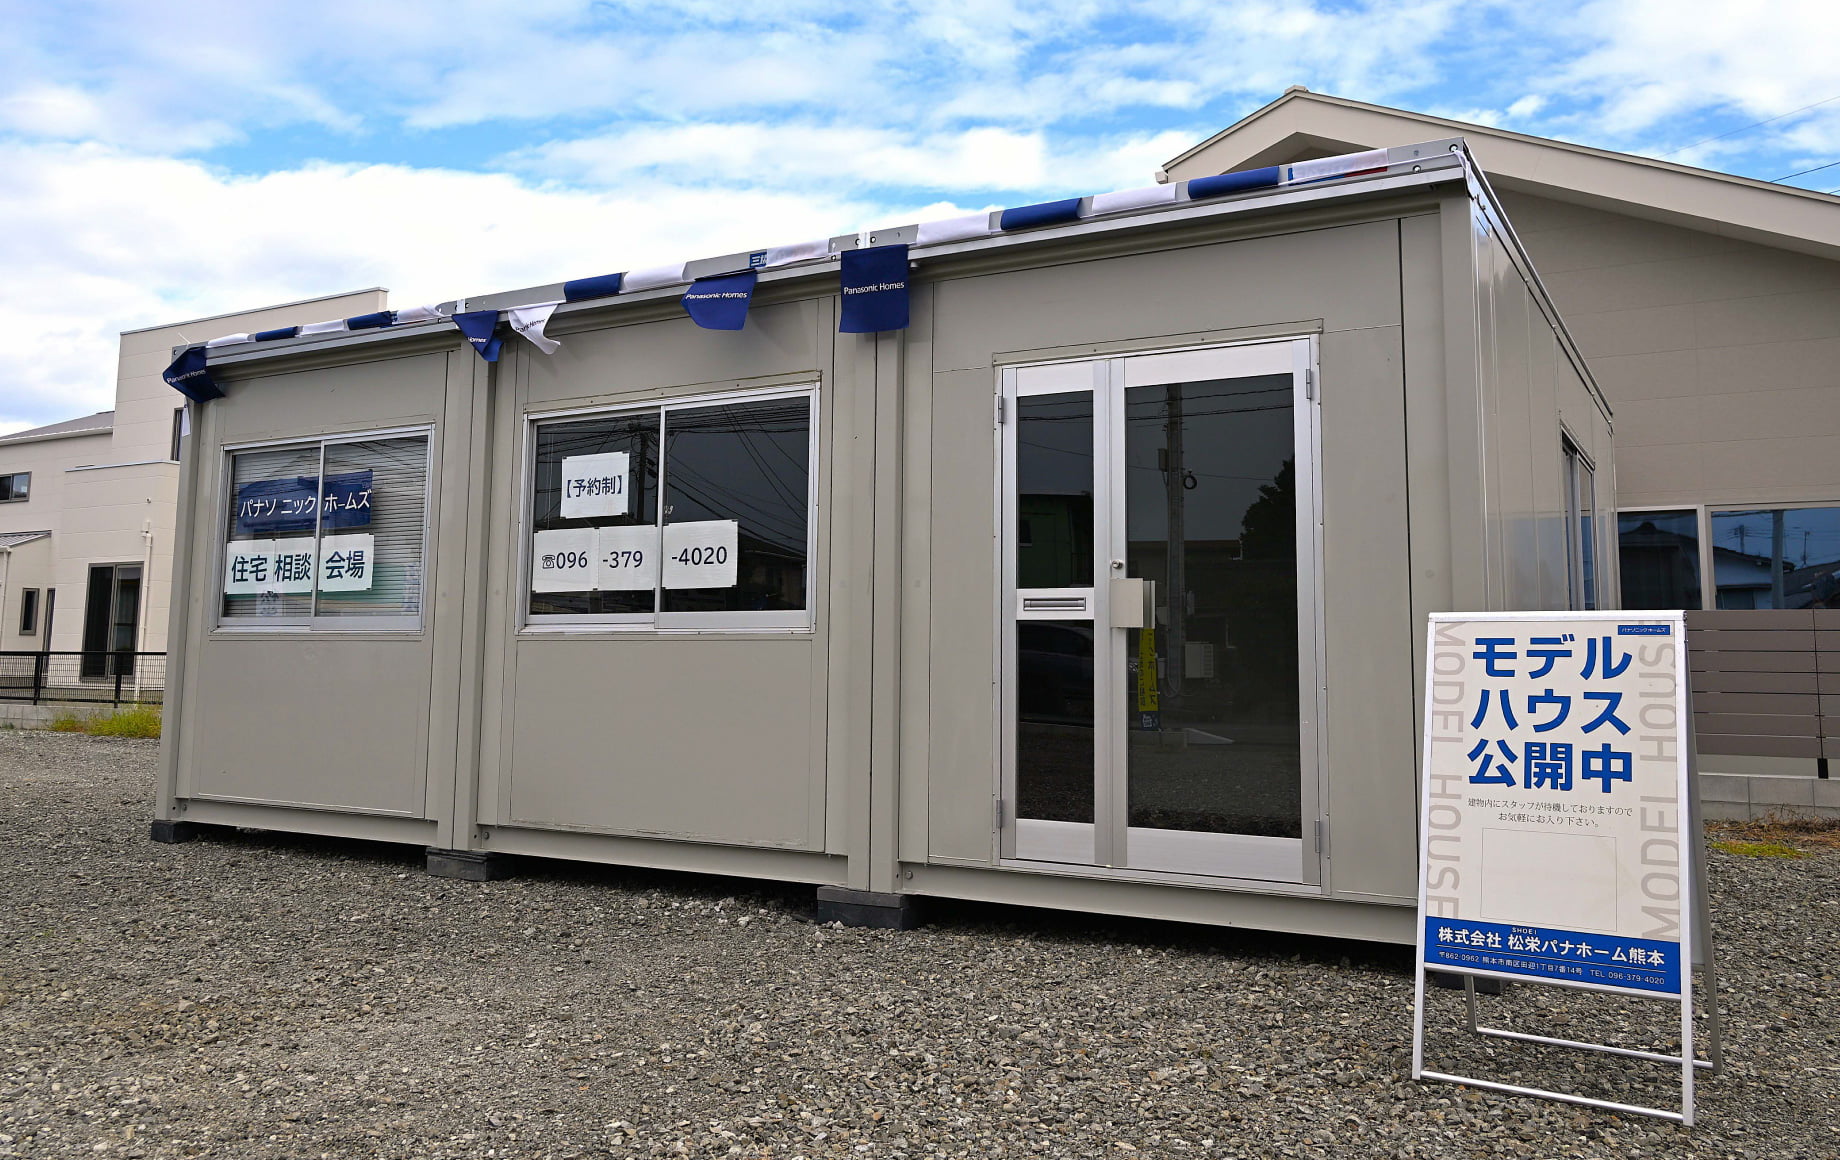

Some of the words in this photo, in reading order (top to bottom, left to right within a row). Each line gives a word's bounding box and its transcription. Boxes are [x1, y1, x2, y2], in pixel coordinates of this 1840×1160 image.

[685, 292, 721, 300] Panasonic
[843, 283, 879, 295] Panasonic
[880, 281, 905, 291] Homes
[566, 475, 623, 499] 【予約制】
[1472, 632, 1633, 681] モデル
[1638, 620, 1678, 763] HOUS
[1470, 687, 1632, 737] ハウス
[1466, 738, 1633, 794] 公開中
[1467, 797, 1633, 817] 建物内にスタッフが待機しておりますので
[1498, 811, 1600, 828] お気軽にお入り下さい。
[1512, 926, 1537, 935] SHOEI
[1438, 925, 1502, 949] 株式会社
[1507, 933, 1665, 967] 松栄パナホーム熊本
[1590, 969, 1606, 978] TEL
[1608, 971, 1665, 985] 096-379-4020
